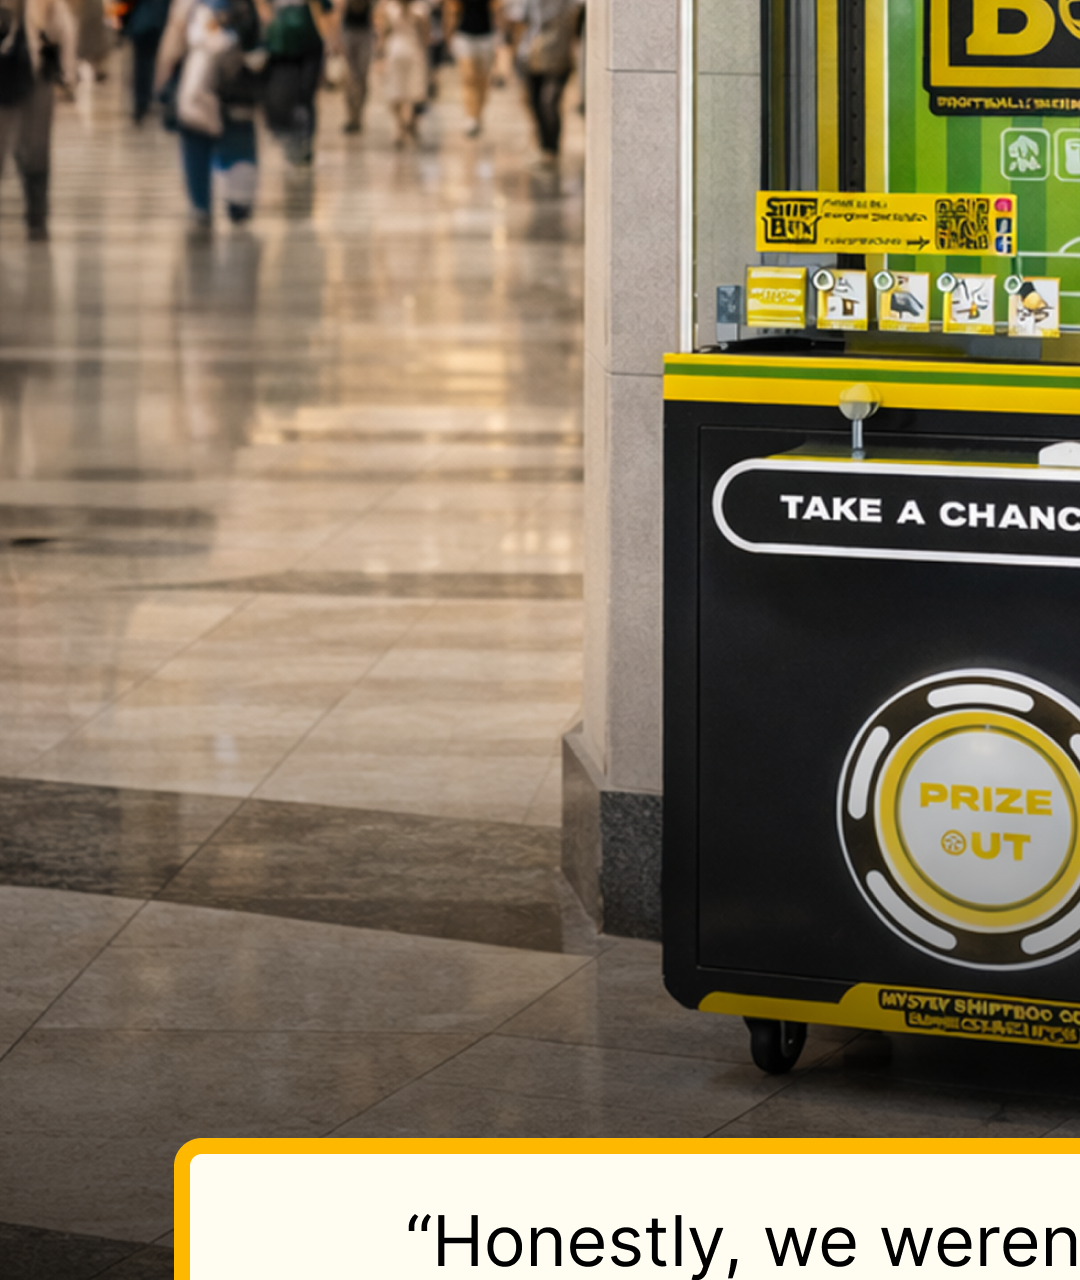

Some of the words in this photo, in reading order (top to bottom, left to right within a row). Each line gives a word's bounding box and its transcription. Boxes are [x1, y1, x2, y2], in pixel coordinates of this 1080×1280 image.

[781, 495, 882, 523] TAKE
[897, 499, 925, 525] A
[920, 783, 1053, 816] PRIZE
